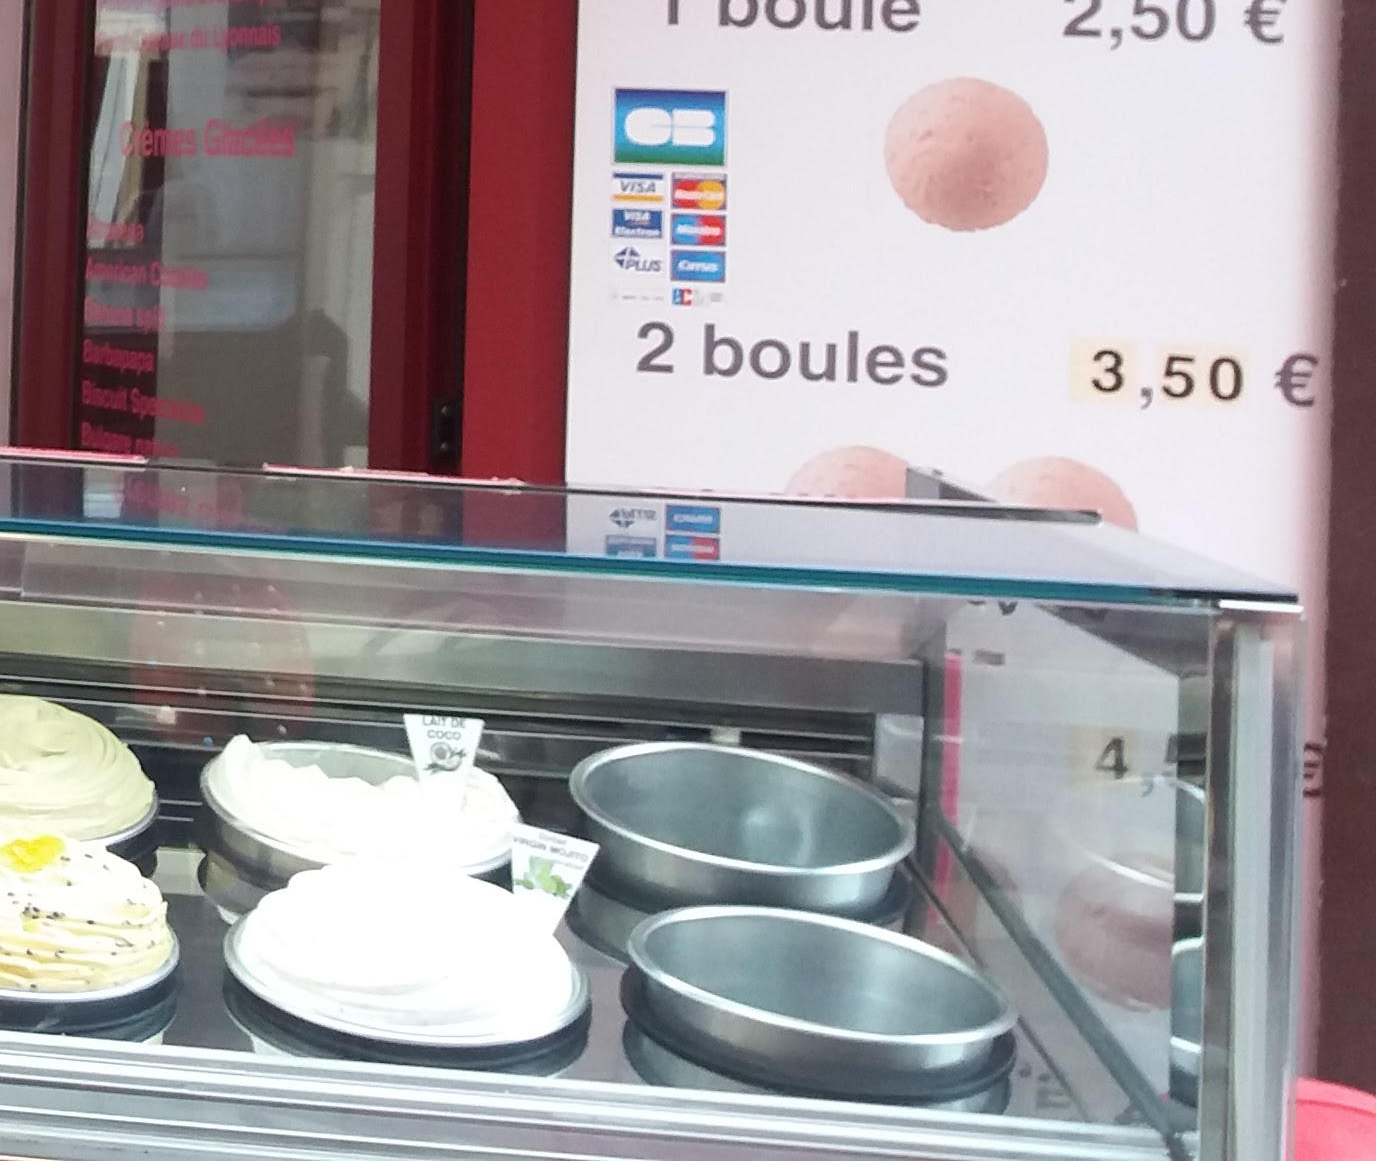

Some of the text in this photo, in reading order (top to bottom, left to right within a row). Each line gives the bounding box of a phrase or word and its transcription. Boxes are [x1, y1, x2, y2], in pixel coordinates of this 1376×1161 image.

[619, 180, 657, 194] VISA
[635, 322, 950, 388] 2 boules
[1090, 349, 1321, 409] 3,50 €
[426, 729, 462, 741] COCO
